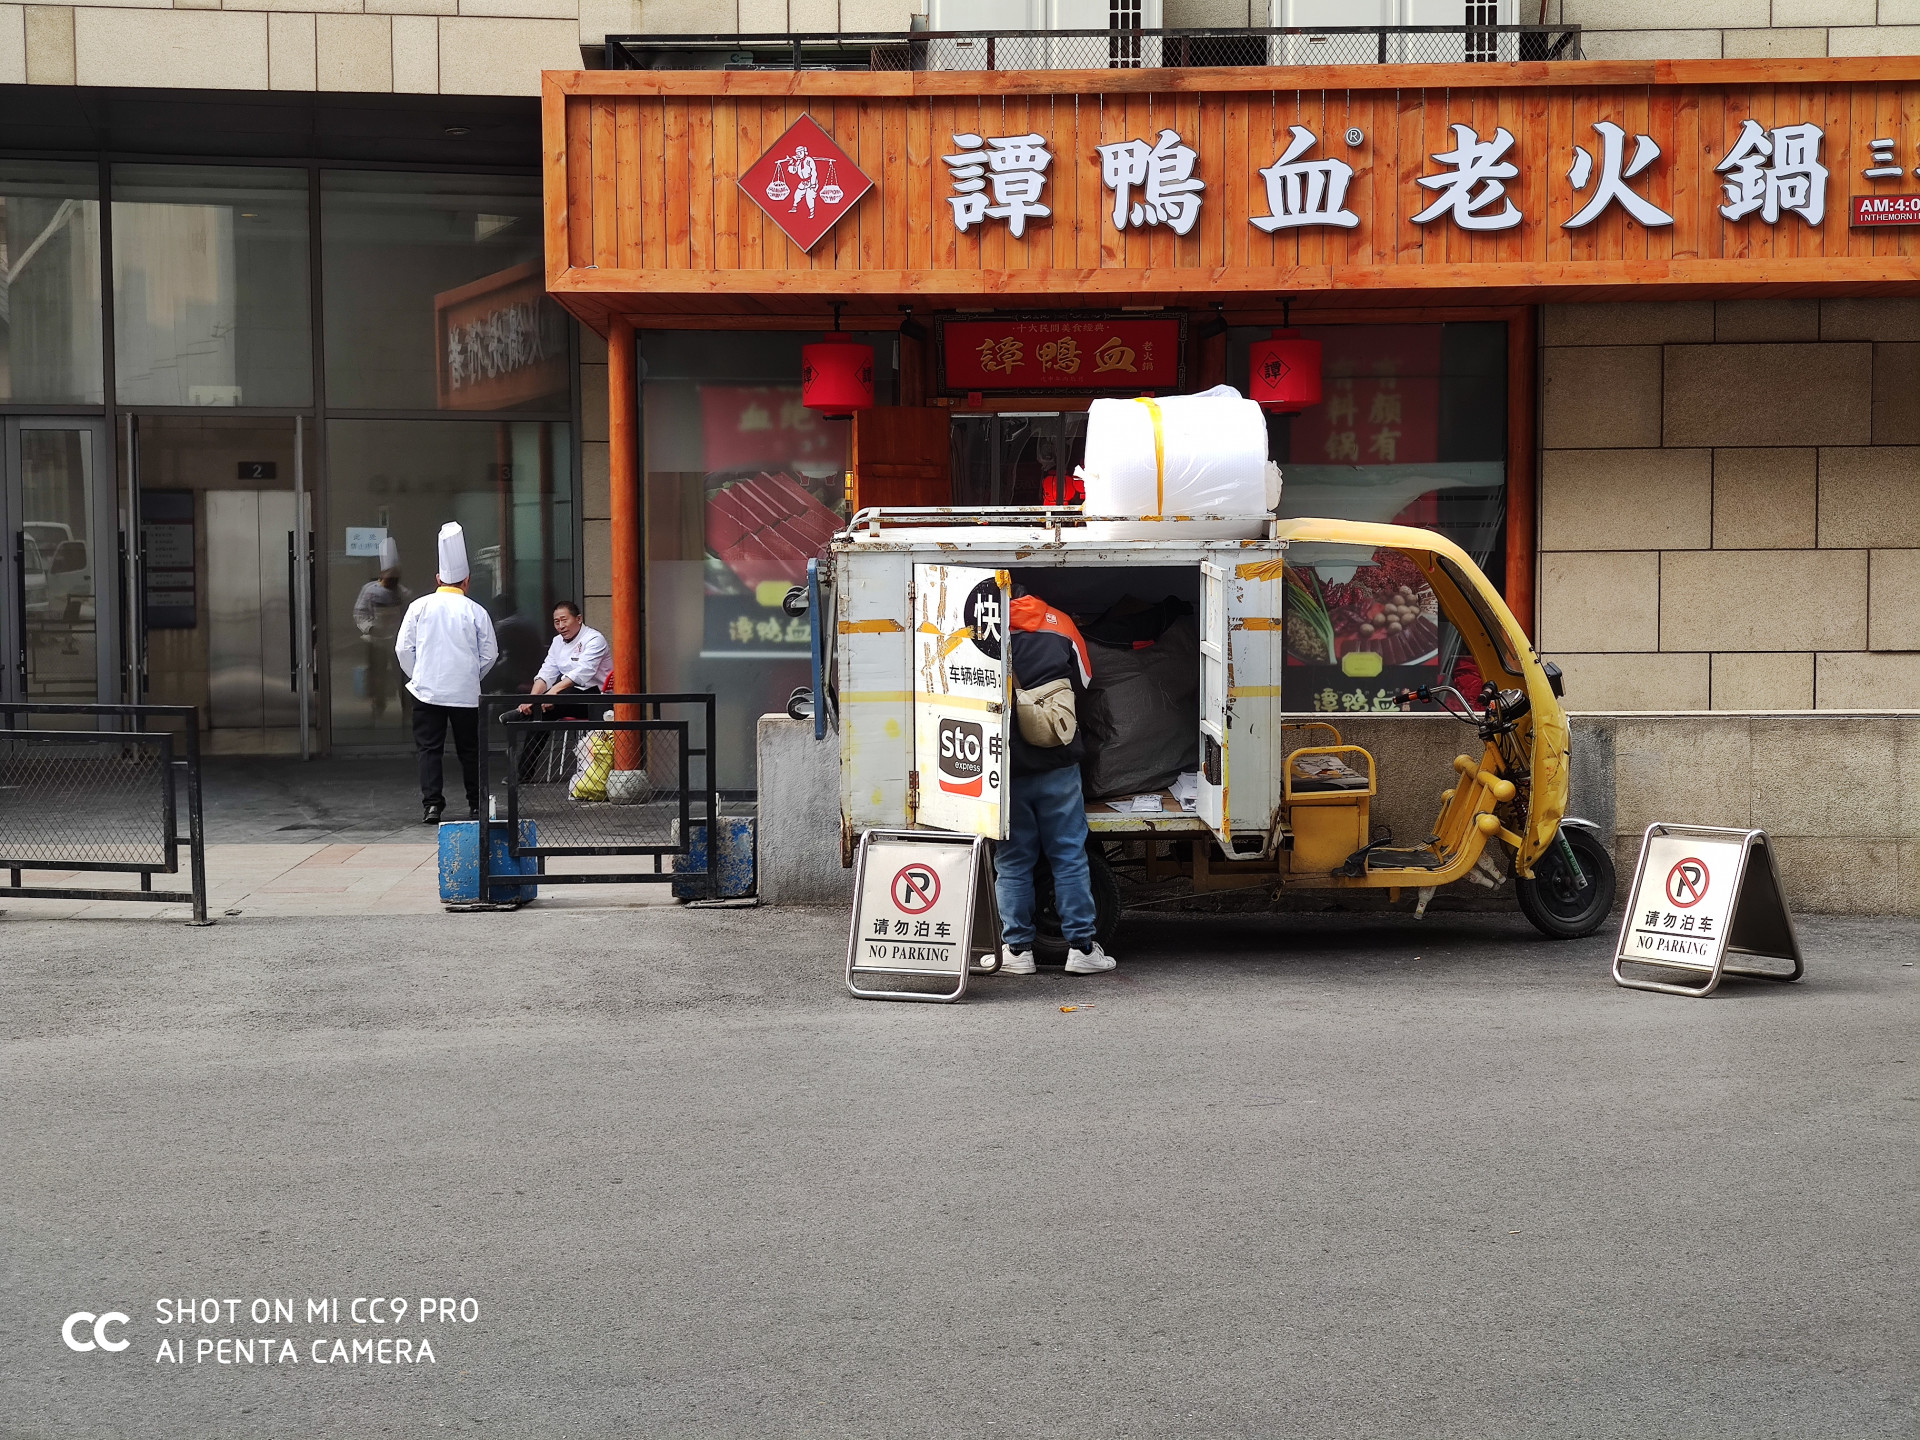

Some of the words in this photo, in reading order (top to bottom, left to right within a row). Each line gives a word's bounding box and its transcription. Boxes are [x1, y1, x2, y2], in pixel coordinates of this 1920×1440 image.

[975, 336, 1138, 375] 譚鴨血
[252, 464, 263, 478] 2
[941, 727, 981, 762] sto
[955, 761, 981, 772] express
[873, 918, 951, 938] 请勿泊车
[1645, 910, 1713, 932] 请勿泊车
[869, 945, 887, 958] NO
[892, 946, 949, 961] PARKING
[1636, 936, 1653, 949] NO
[1657, 938, 1708, 956] PARKING
